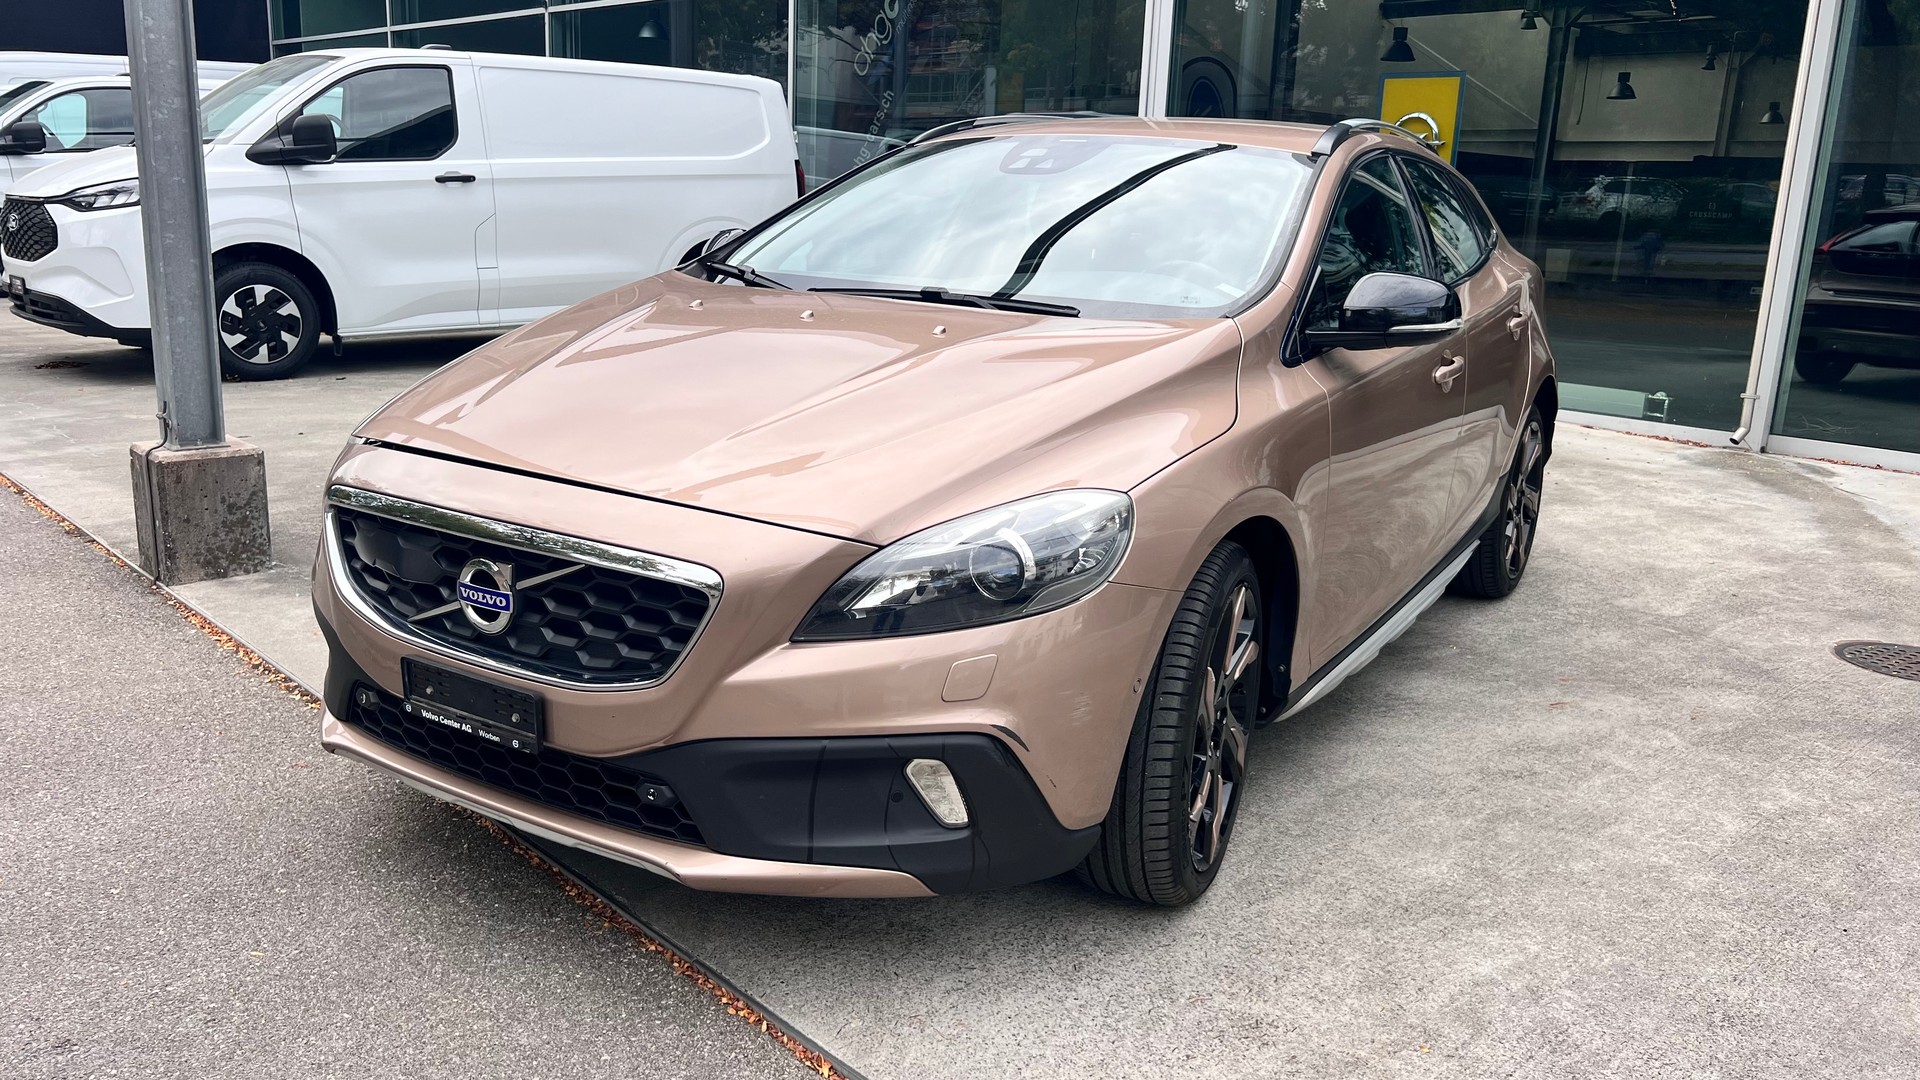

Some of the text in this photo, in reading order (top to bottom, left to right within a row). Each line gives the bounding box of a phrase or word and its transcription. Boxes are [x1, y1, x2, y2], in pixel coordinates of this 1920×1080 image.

[853, 90, 895, 168] hg-cars.ch
[460, 587, 507, 607] VOLVO
[421, 709, 501, 743] Volvo Center AG Worben
